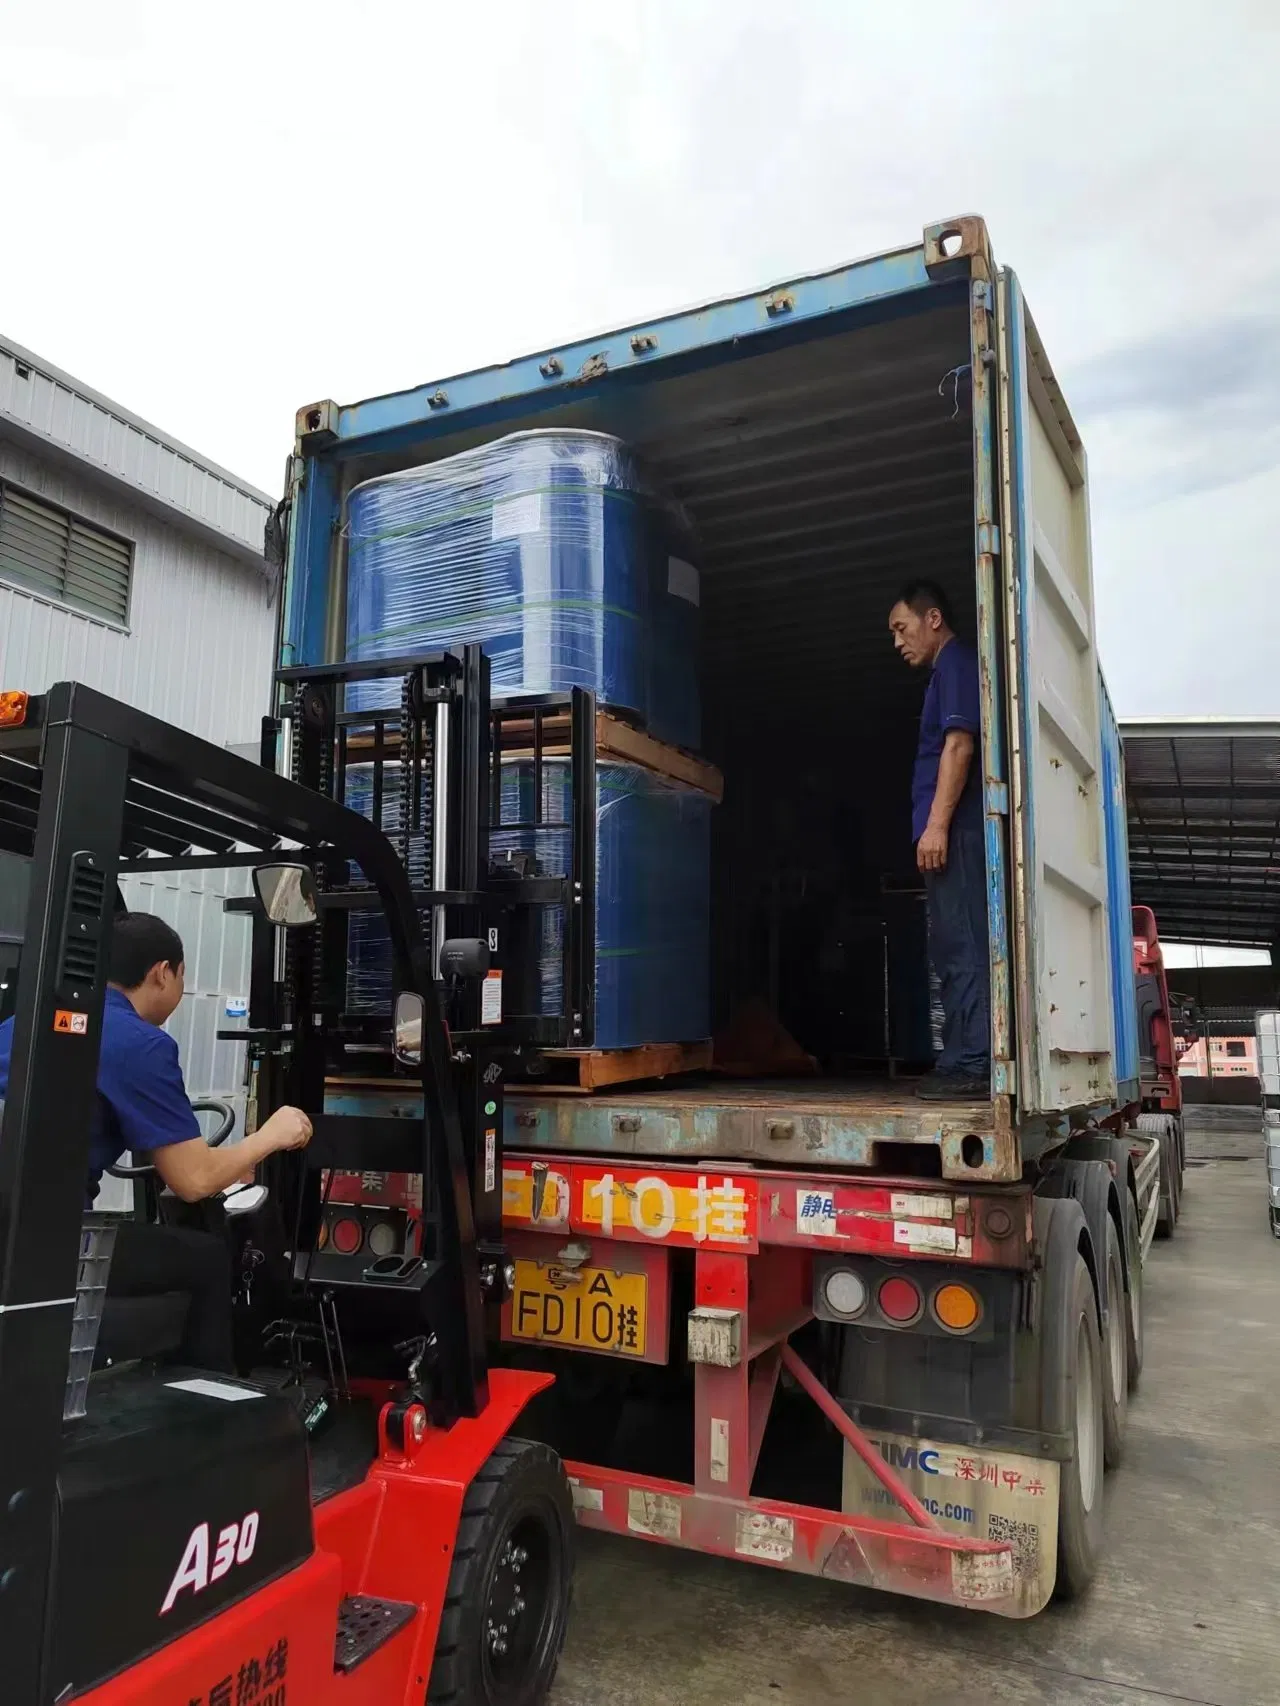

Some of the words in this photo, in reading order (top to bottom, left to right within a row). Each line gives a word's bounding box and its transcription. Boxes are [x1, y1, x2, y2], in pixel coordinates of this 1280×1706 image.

[518, 1290, 638, 1348] FD10挂
[868, 1439, 940, 1475] IMC
[158, 1510, 260, 1617] A30
[189, 1636, 289, 1706] 后热线
